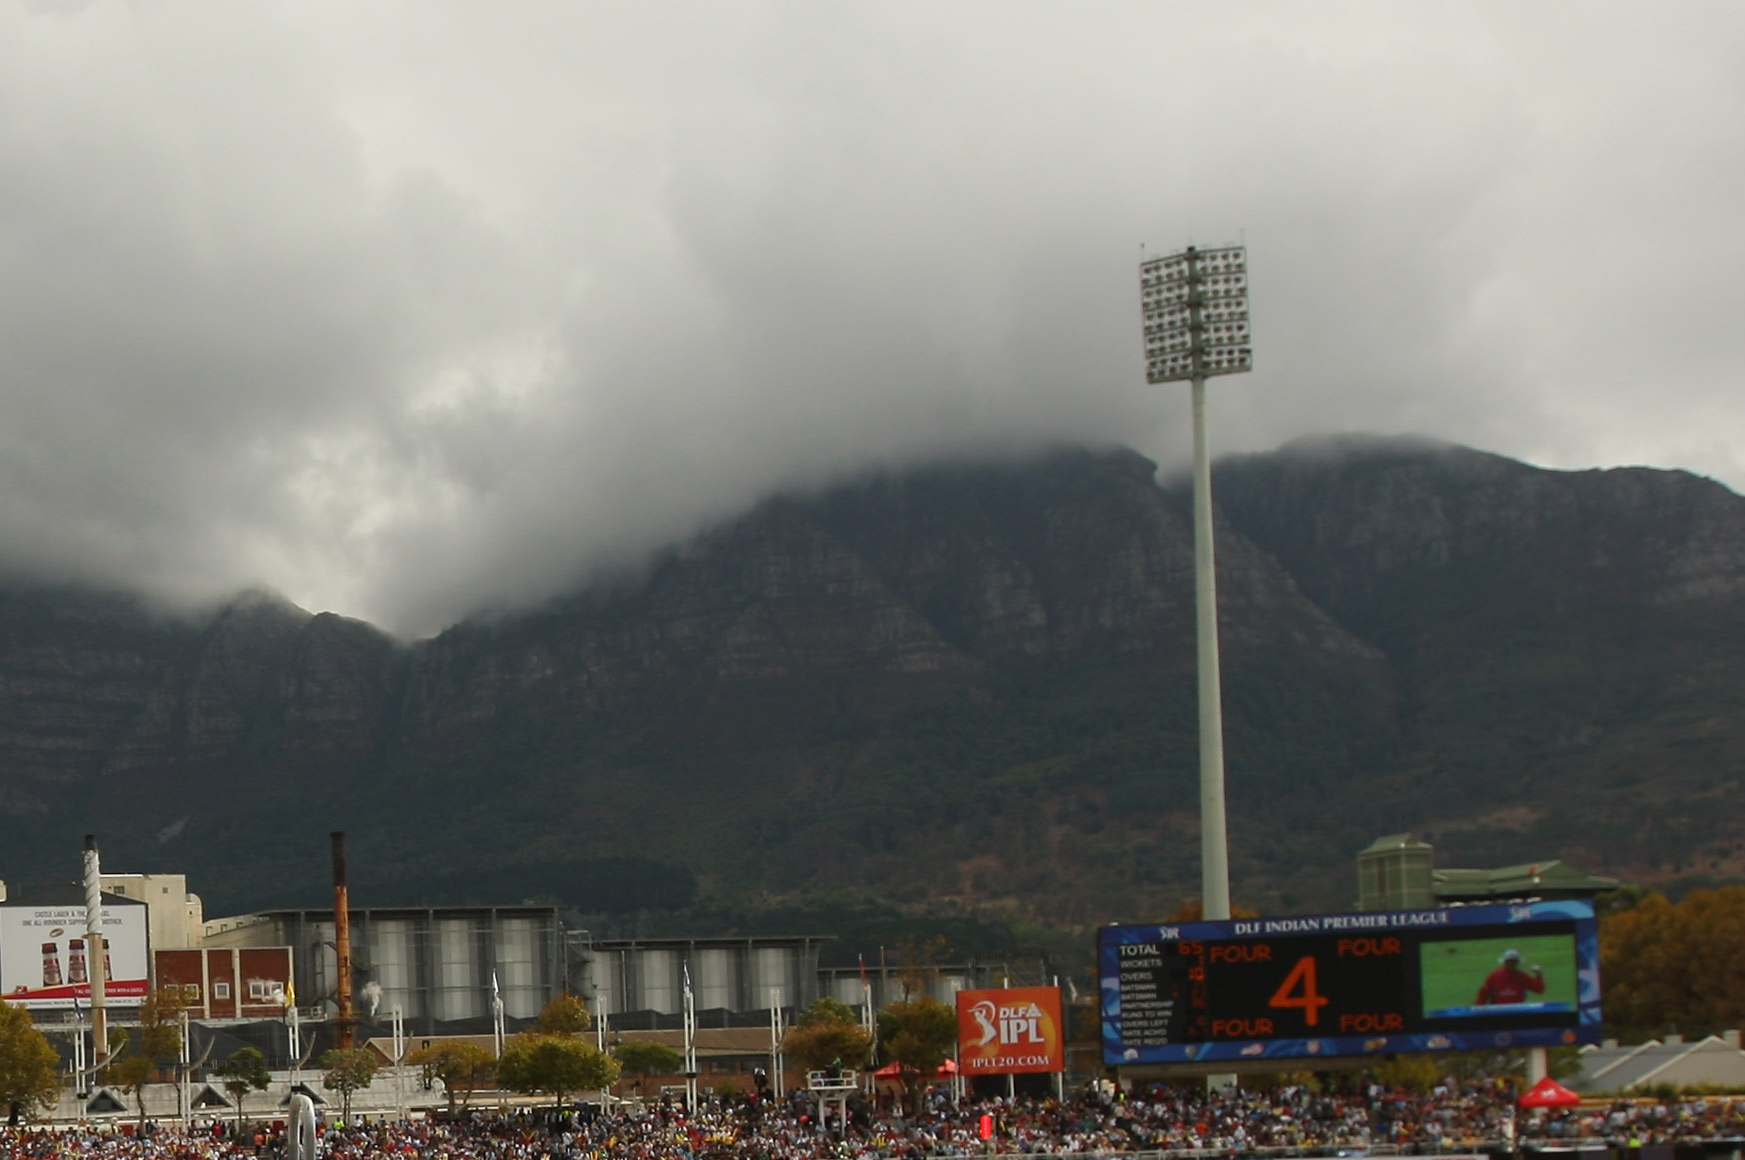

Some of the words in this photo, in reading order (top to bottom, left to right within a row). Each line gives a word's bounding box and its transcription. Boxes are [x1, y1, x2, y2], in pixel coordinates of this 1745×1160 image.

[1235, 922, 1262, 935] DLF
[1265, 920, 1320, 934] INDIAN
[1323, 914, 1388, 931] PREMIER
[1391, 912, 1449, 926] LEAGUE
[1119, 944, 1160, 956] TOTAL
[1210, 945, 1272, 964] FOUR
[1337, 937, 1402, 957] FOUR
[1120, 958, 1162, 969] WICKETS
[1120, 971, 1153, 982] OVERS
[1269, 955, 1329, 1027] 4
[999, 1006, 1028, 1019] DLF
[999, 1019, 1045, 1044] IPL
[1211, 1018, 1274, 1037] FOUR
[1339, 1013, 1404, 1033] FOUR
[972, 1055, 1050, 1068] IPLT20.COM
